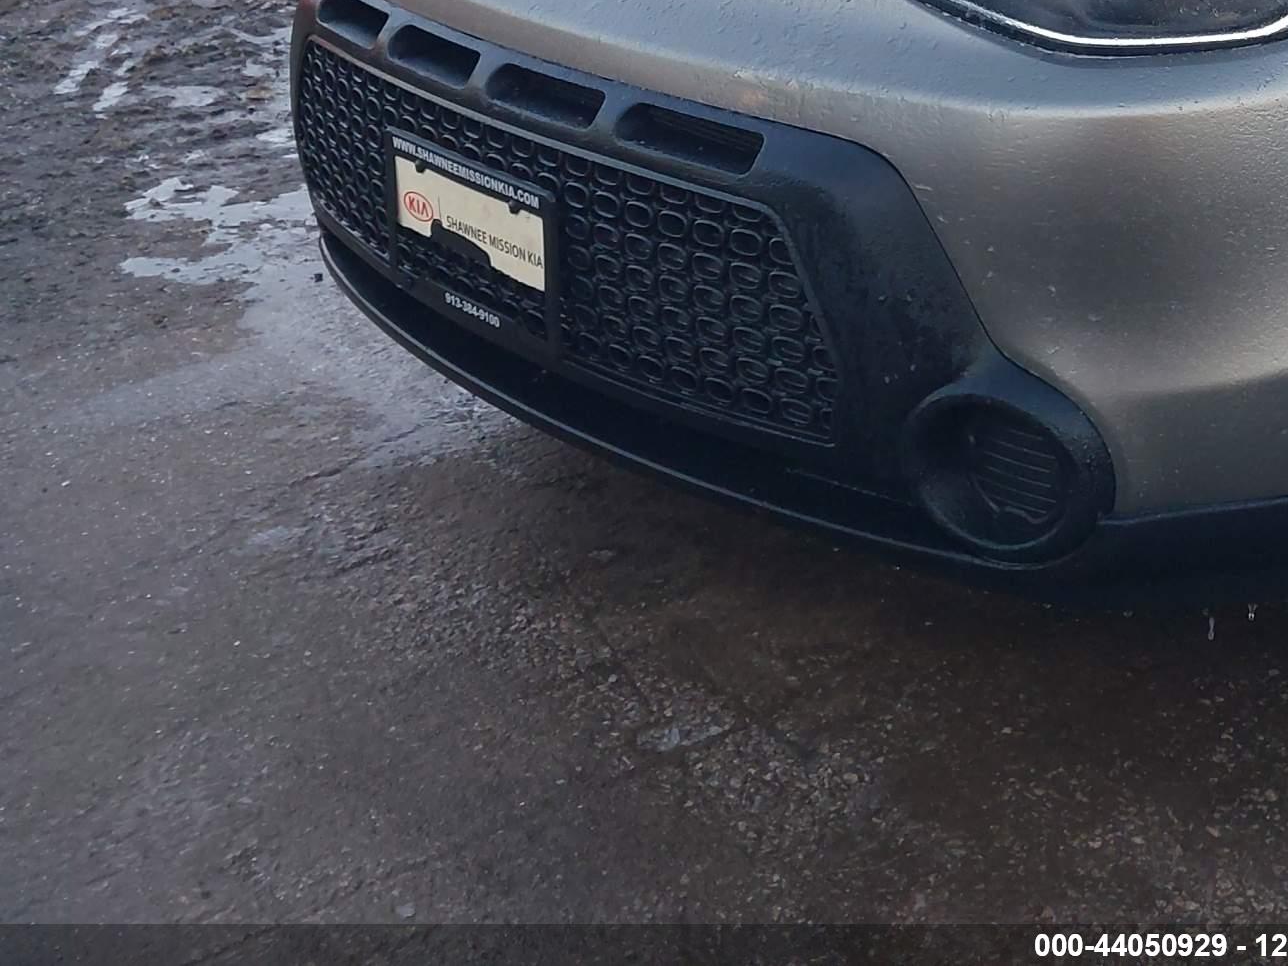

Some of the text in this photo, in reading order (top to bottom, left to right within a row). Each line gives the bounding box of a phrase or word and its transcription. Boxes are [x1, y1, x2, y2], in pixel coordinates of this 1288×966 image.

[407, 194, 429, 218] KIA
[446, 215, 544, 270] SHAWNEE MISSION KIA
